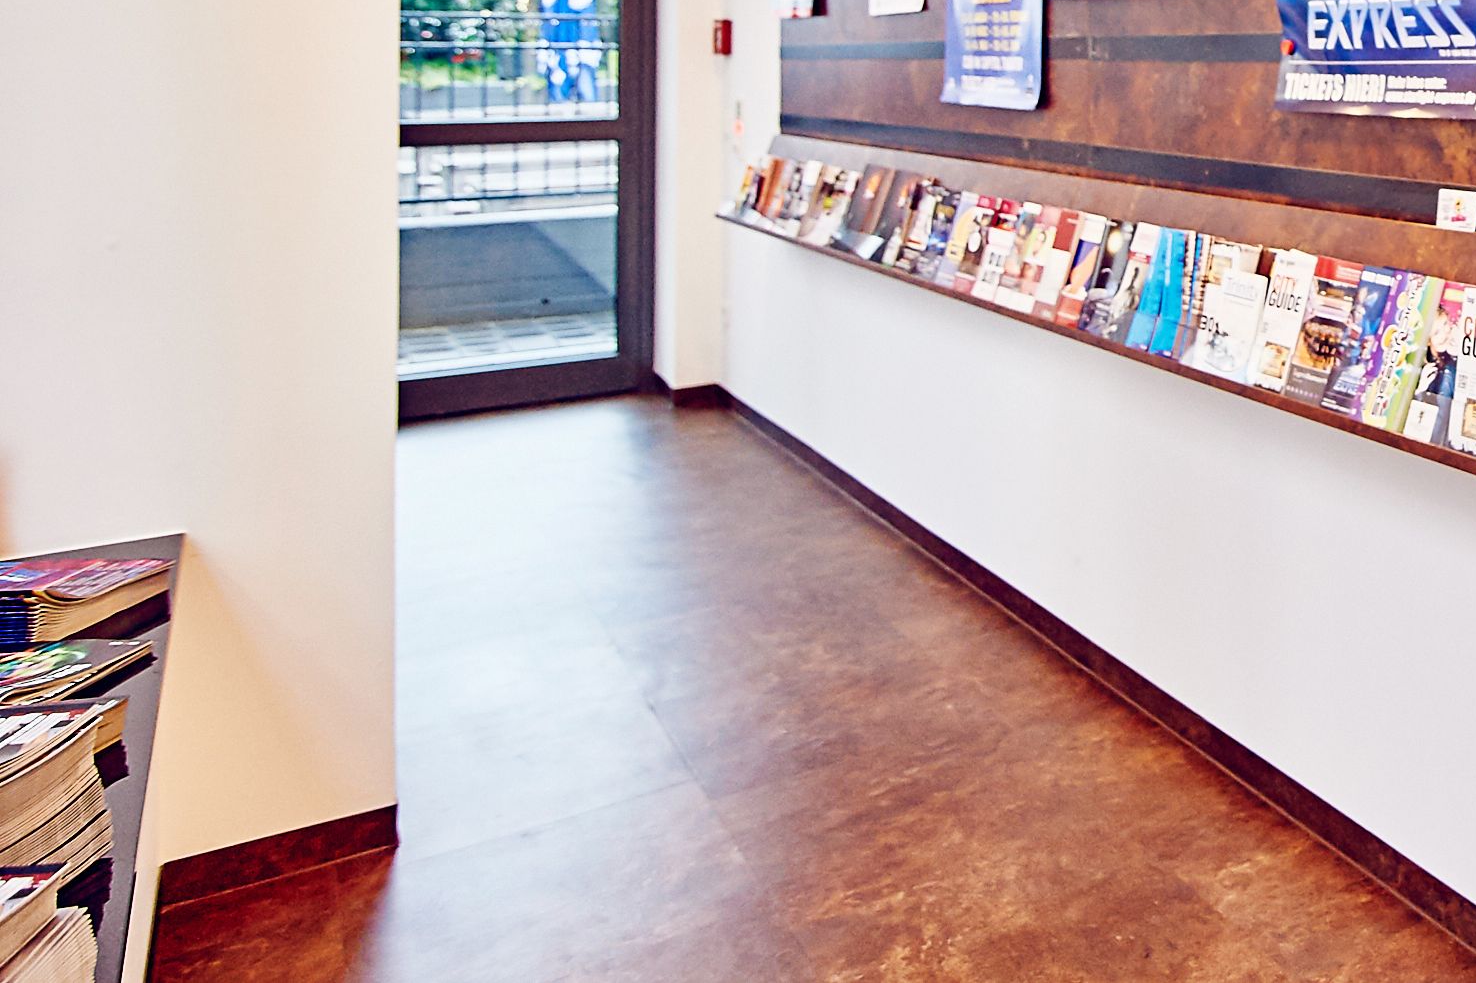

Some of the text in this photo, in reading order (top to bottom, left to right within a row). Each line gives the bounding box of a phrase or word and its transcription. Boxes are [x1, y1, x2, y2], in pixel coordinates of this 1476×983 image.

[1284, 72, 1345, 102] TICKETS
[1344, 74, 1386, 103] HIER!
[1268, 290, 1303, 313] GUIDE
